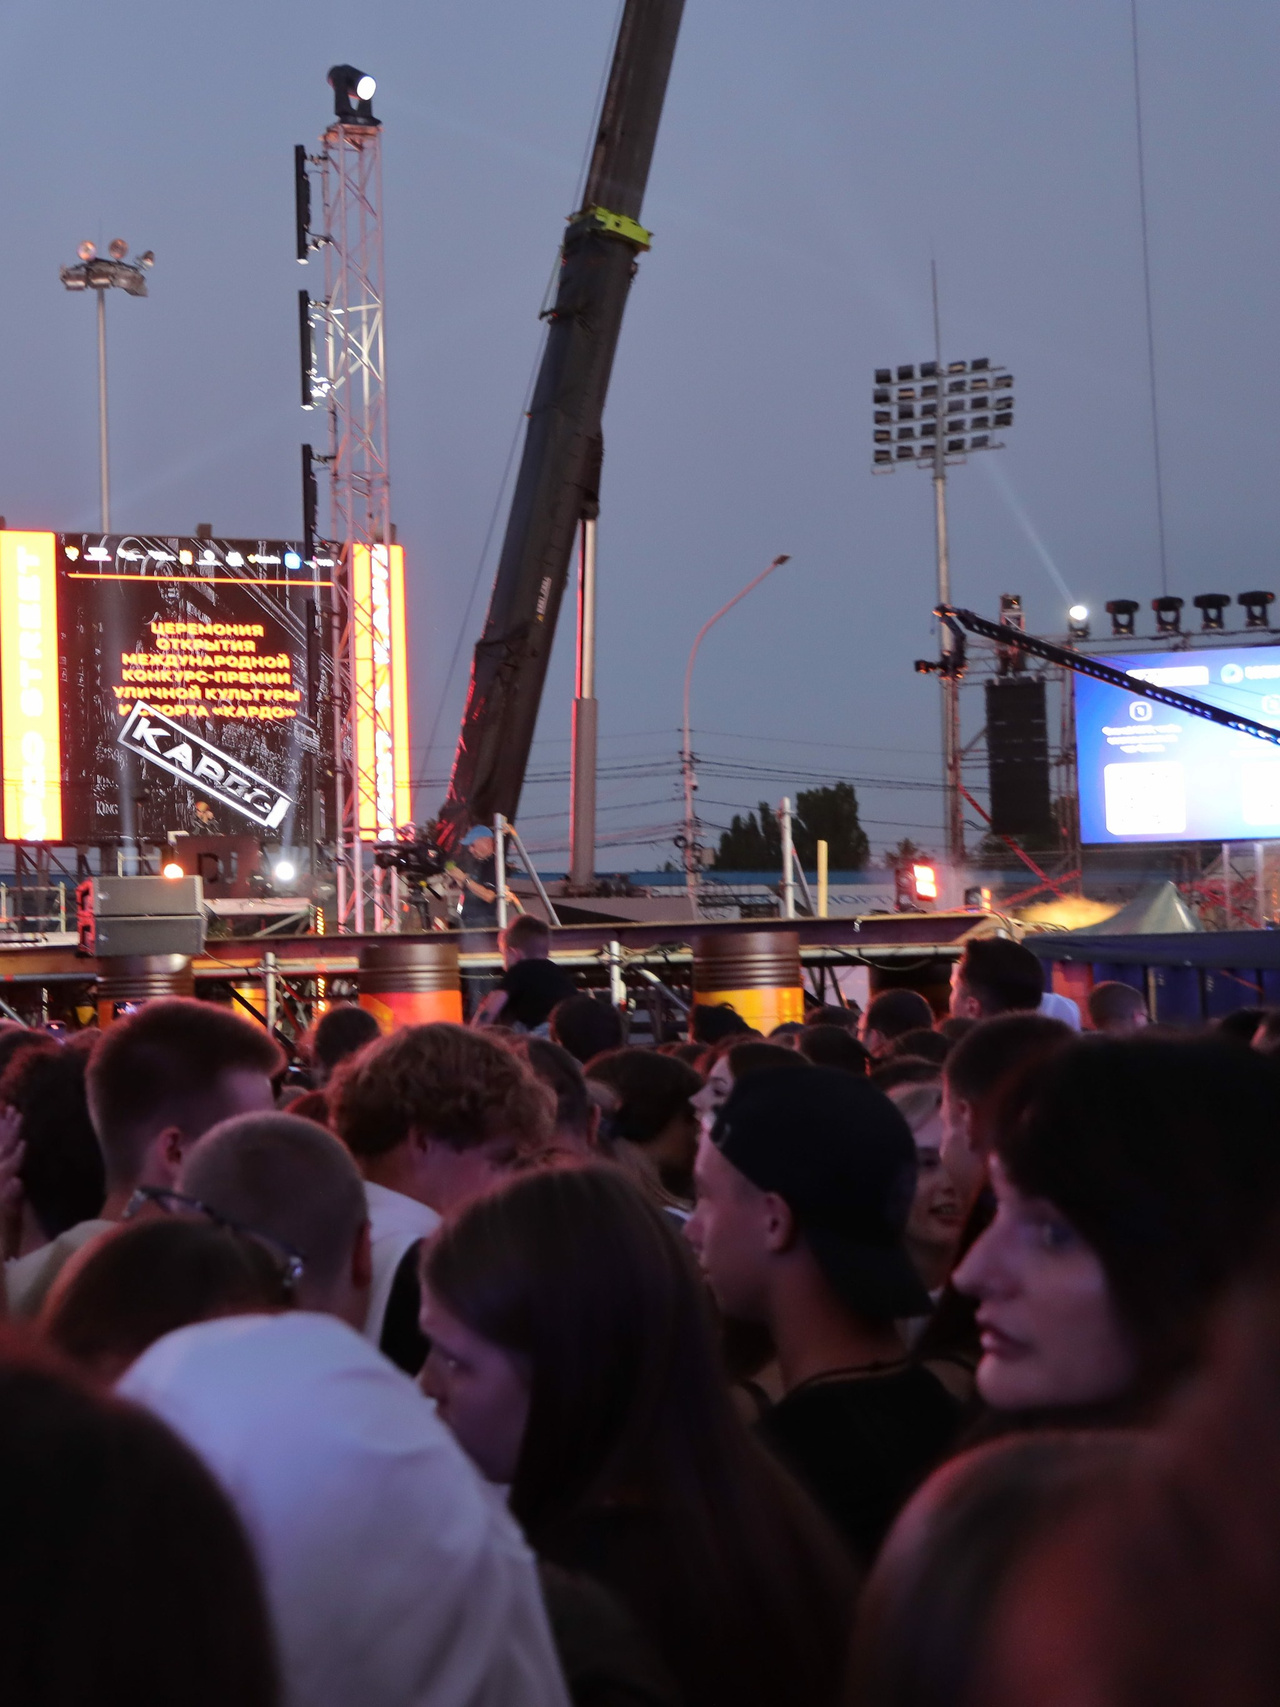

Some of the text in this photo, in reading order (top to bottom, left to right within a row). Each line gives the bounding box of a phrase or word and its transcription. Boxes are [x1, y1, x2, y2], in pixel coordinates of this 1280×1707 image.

[17, 545, 45, 718] STREET
[150, 621, 265, 637] ЦЕРЕМОНИЯ
[155, 638, 257, 652] ОТКРЫТИЯ
[121, 652, 291, 670] МЕЖДУНАРОДНОЙ
[121, 669, 291, 685] КОНКУРС-ПРЕМИИ
[112, 684, 301, 702] УЛИЧНОЙ КУЛЬТУРЫ
[211, 704, 297, 721] «КАРДО»
[197, 851, 238, 884] DJ
